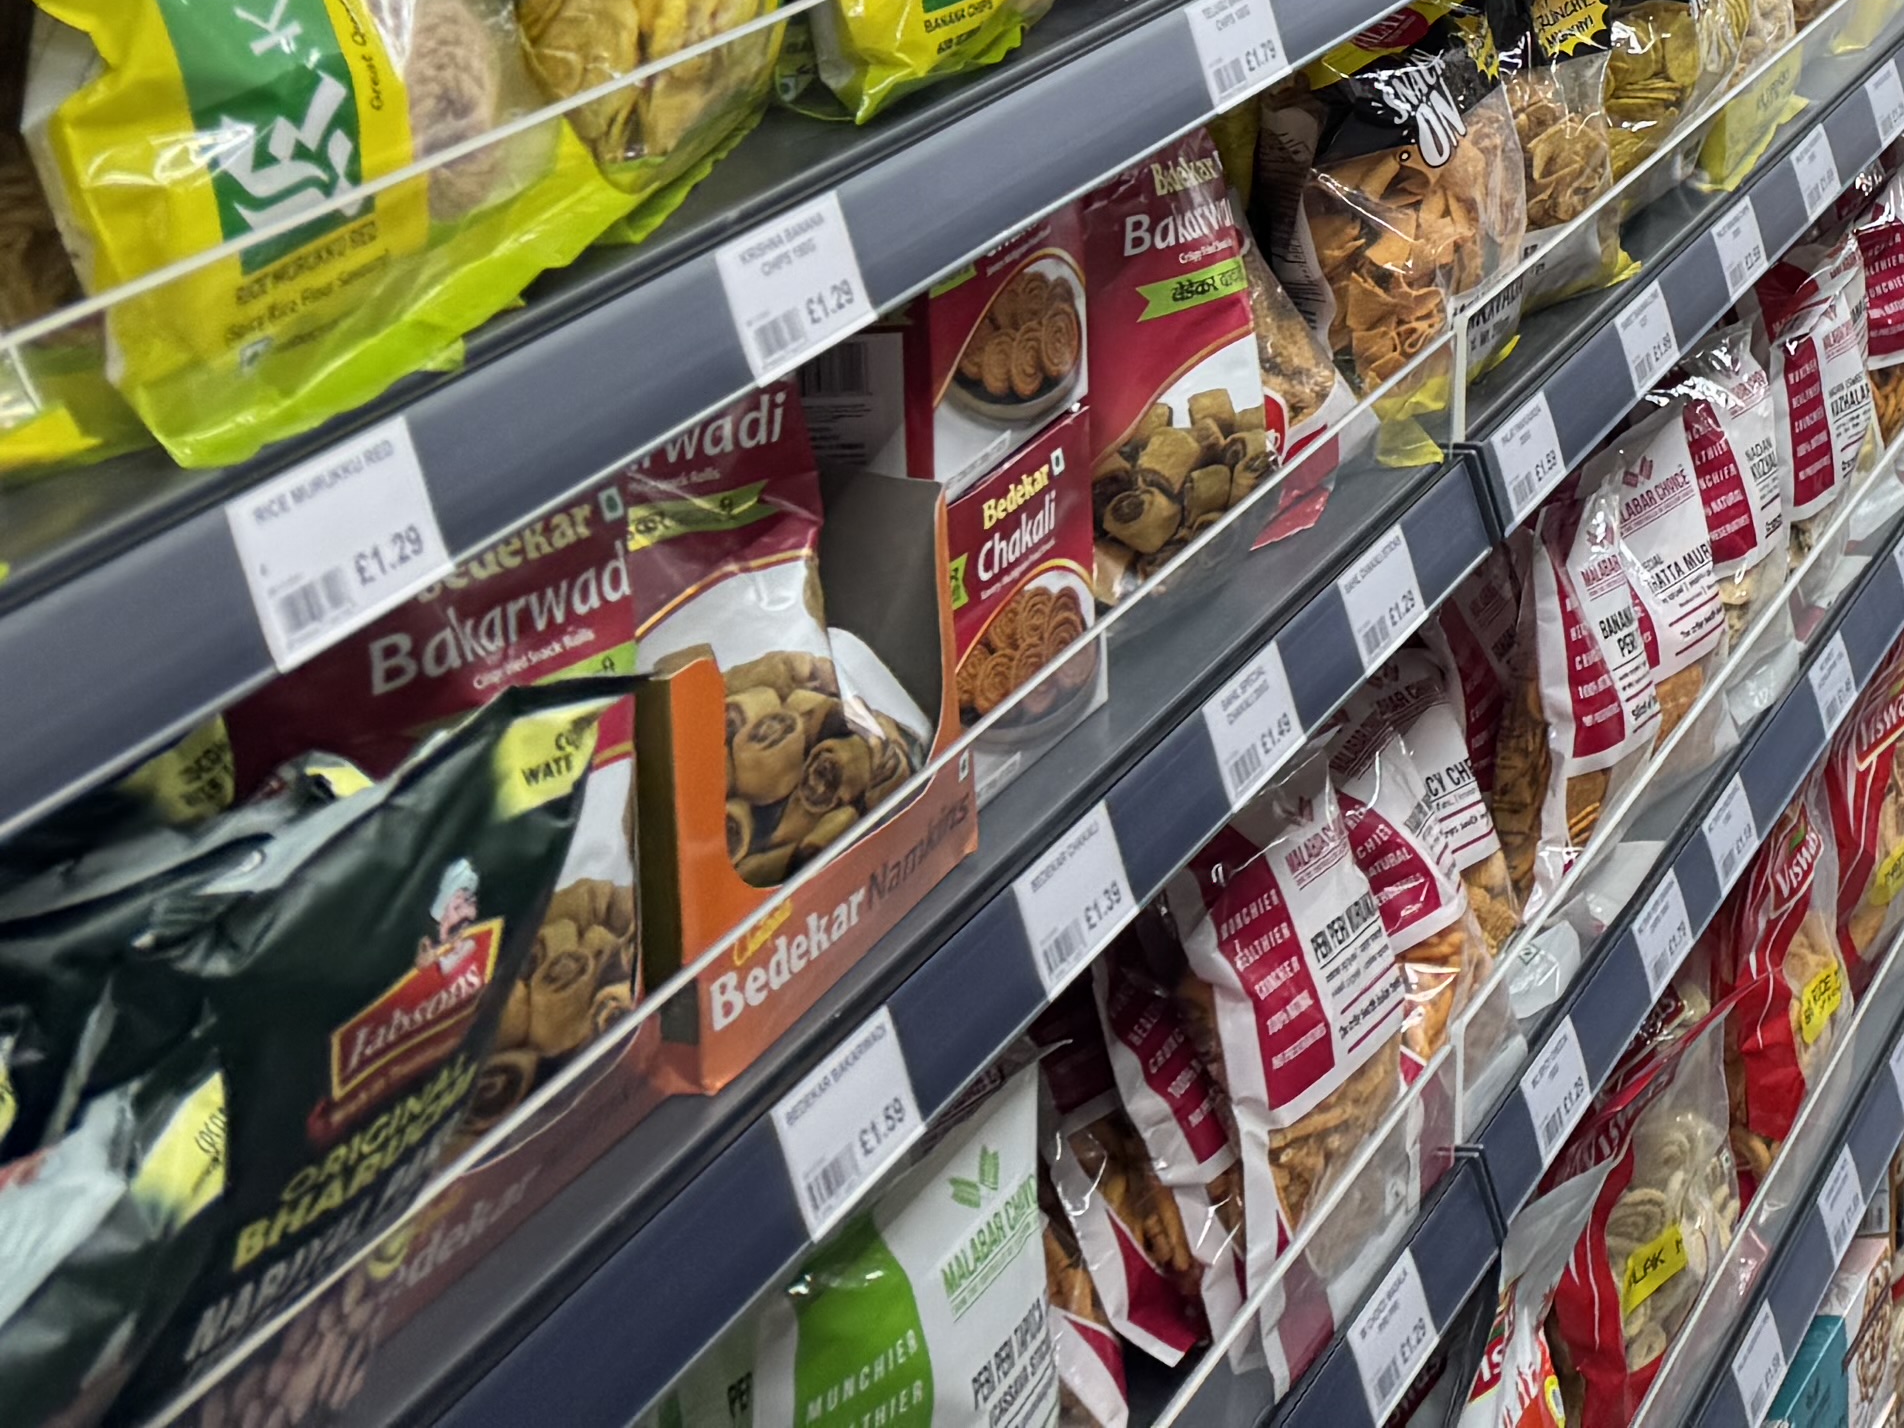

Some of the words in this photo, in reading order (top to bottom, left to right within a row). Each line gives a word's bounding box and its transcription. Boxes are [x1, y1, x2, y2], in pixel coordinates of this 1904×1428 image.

[1246, 40, 1277, 73] £1.79
[1418, 80, 1466, 167] ON
[806, 280, 853, 325] £1.29
[982, 459, 1050, 530] Bedekar
[354, 526, 424, 587] £1.29
[978, 491, 1056, 582] Chakali
[369, 544, 632, 694] Bakarwad
[1388, 587, 1416, 628] £1.29
[1260, 713, 1293, 756] £1.49
[1084, 882, 1122, 931] £1.39
[707, 884, 869, 1032] Bedekar
[858, 1095, 907, 1159] £1.59
[806, 1327, 918, 1420] MUNCHIER
